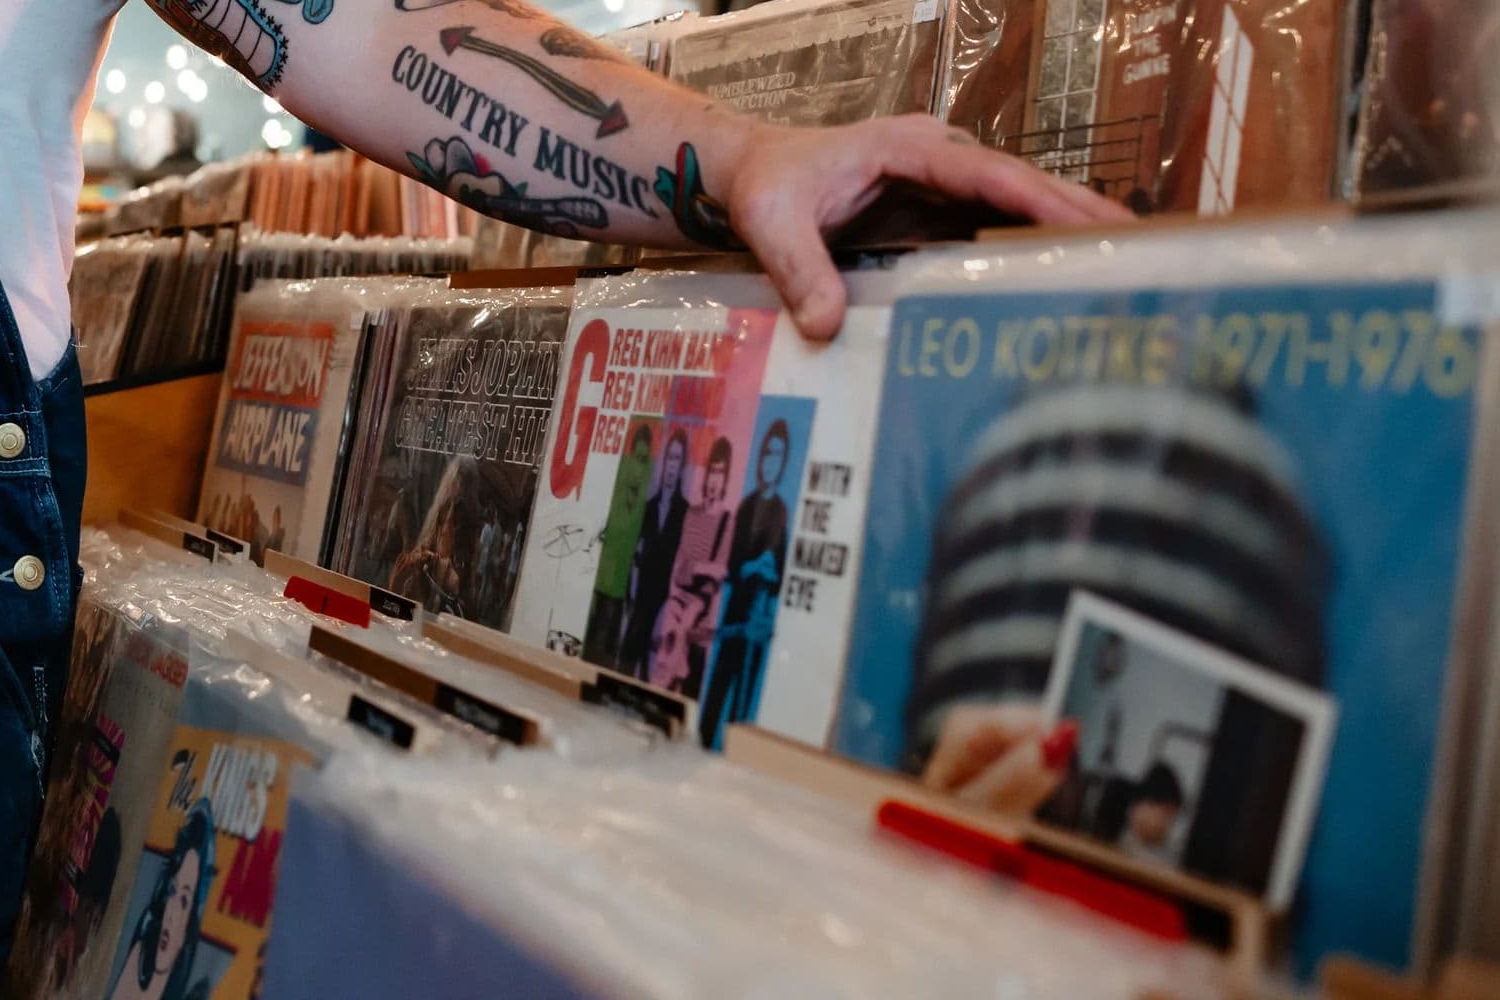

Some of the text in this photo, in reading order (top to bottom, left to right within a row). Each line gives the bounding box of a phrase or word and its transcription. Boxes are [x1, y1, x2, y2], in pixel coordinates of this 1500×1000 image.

[392, 45, 659, 218] COUNTRY MUSIC
[901, 309, 1479, 397] LEO KOTTKE 1971-1976
[222, 401, 311, 472] AIRPLANE
[395, 395, 511, 461] GREATEST
[808, 461, 853, 498] WITH
[801, 499, 832, 534] THE
[794, 538, 849, 578] NAKED
[784, 574, 818, 613] EYE
